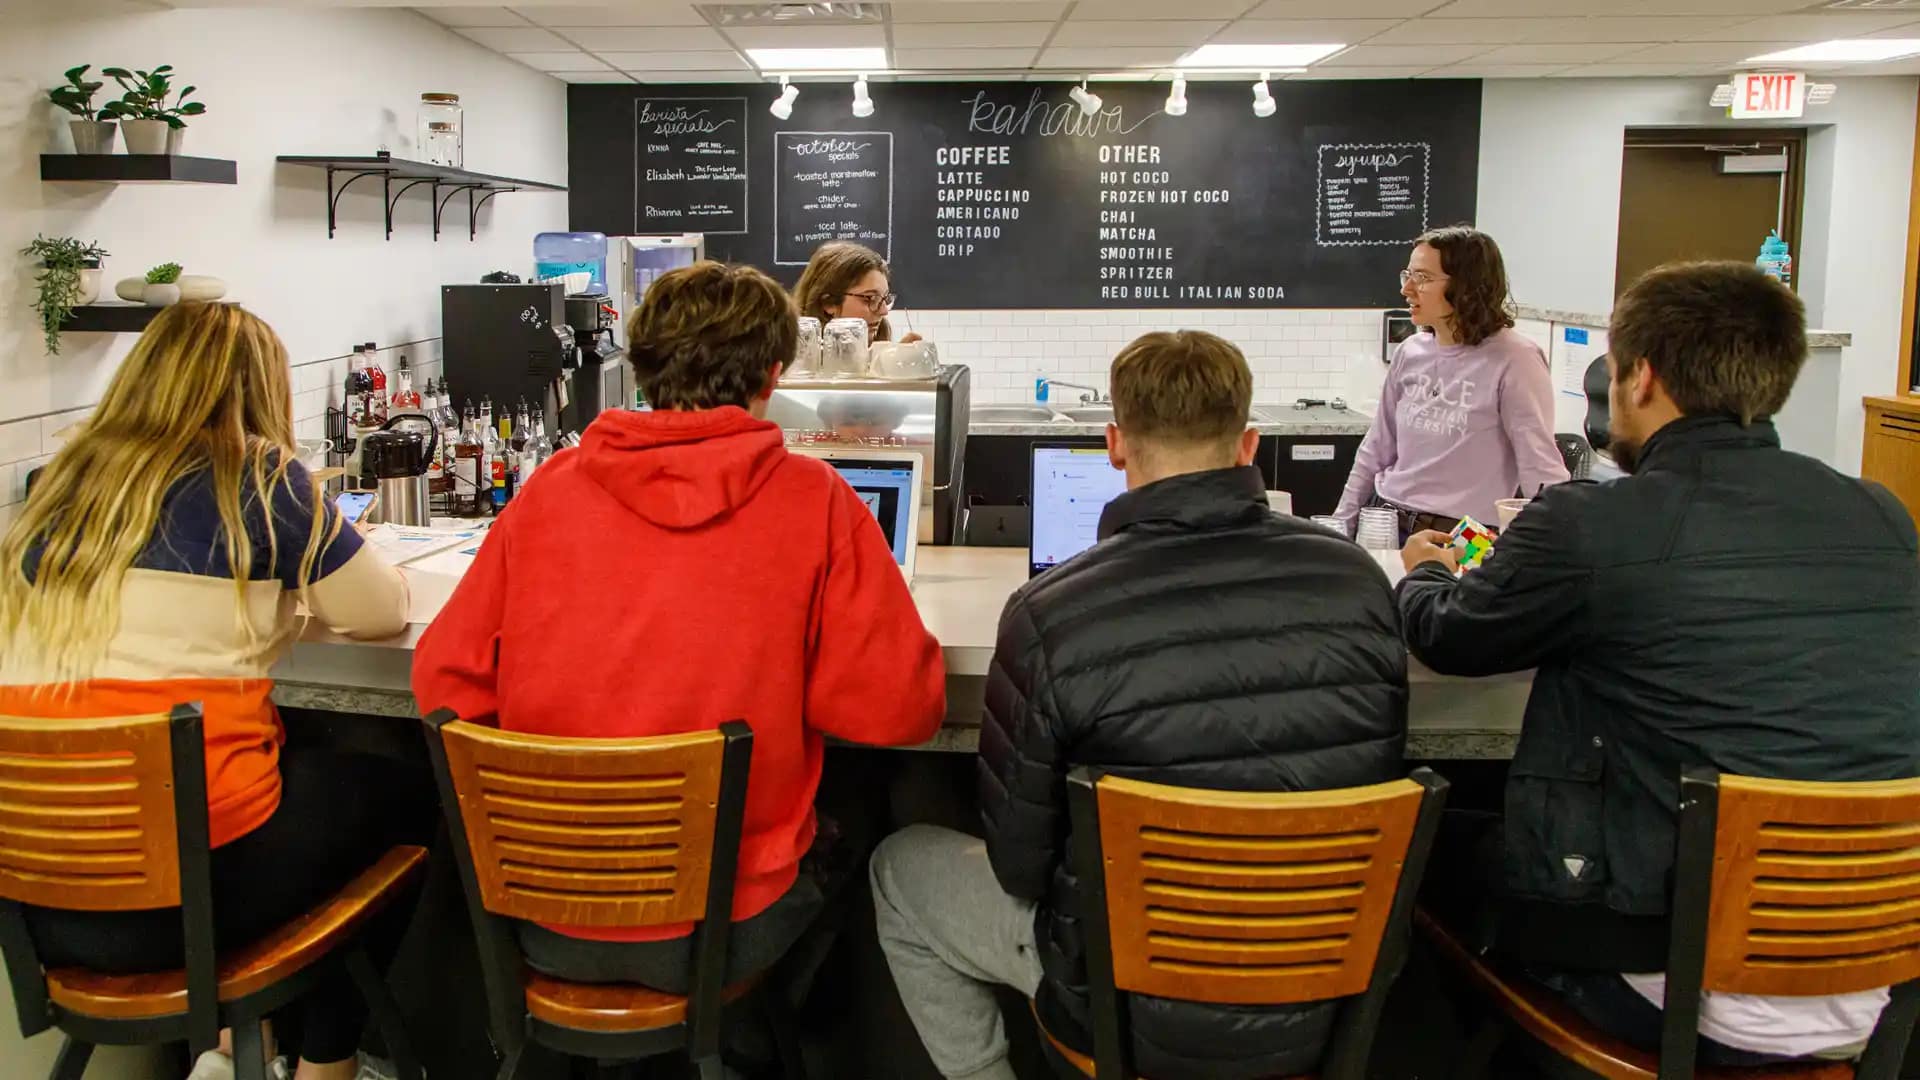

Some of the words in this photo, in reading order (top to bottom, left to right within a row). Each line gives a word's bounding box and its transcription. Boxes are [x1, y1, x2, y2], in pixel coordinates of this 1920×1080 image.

[1745, 75, 1796, 111] EXIT
[654, 118, 736, 138] specials
[787, 138, 871, 156] october
[828, 151, 860, 164] specials
[936, 146, 1010, 166] COFFEE
[1099, 144, 1161, 165] OTHER
[1335, 153, 1413, 175] syrups
[646, 168, 684, 181] Elisabeth
[795, 171, 827, 181] toasted
[937, 171, 983, 185] LATTE
[1100, 170, 1128, 187] HOT
[1132, 170, 1170, 186] COCO
[821, 180, 840, 188] latte
[818, 194, 846, 203] chider
[937, 188, 1030, 203] CAPPUCCINO
[1100, 190, 1156, 204] FROZEN
[1160, 189, 1188, 204] HOT
[1193, 189, 1230, 204] COCO
[645, 205, 682, 217] Rhianna
[936, 206, 1020, 220] AMERICANO
[1100, 210, 1135, 224] CHAI
[840, 221, 859, 230] latte
[937, 225, 1001, 239] CORTADO
[1099, 227, 1156, 241] MATCHA
[938, 243, 974, 257] DRIP
[1100, 246, 1173, 260] SMOOTHIE
[1100, 266, 1173, 280] SPRITZER
[1101, 285, 1128, 299] RED
[1134, 286, 1170, 299] BULL
[1179, 286, 1242, 299] ITALIAN
[1248, 286, 1285, 299] SODA
[1400, 372, 1476, 409] GRACE
